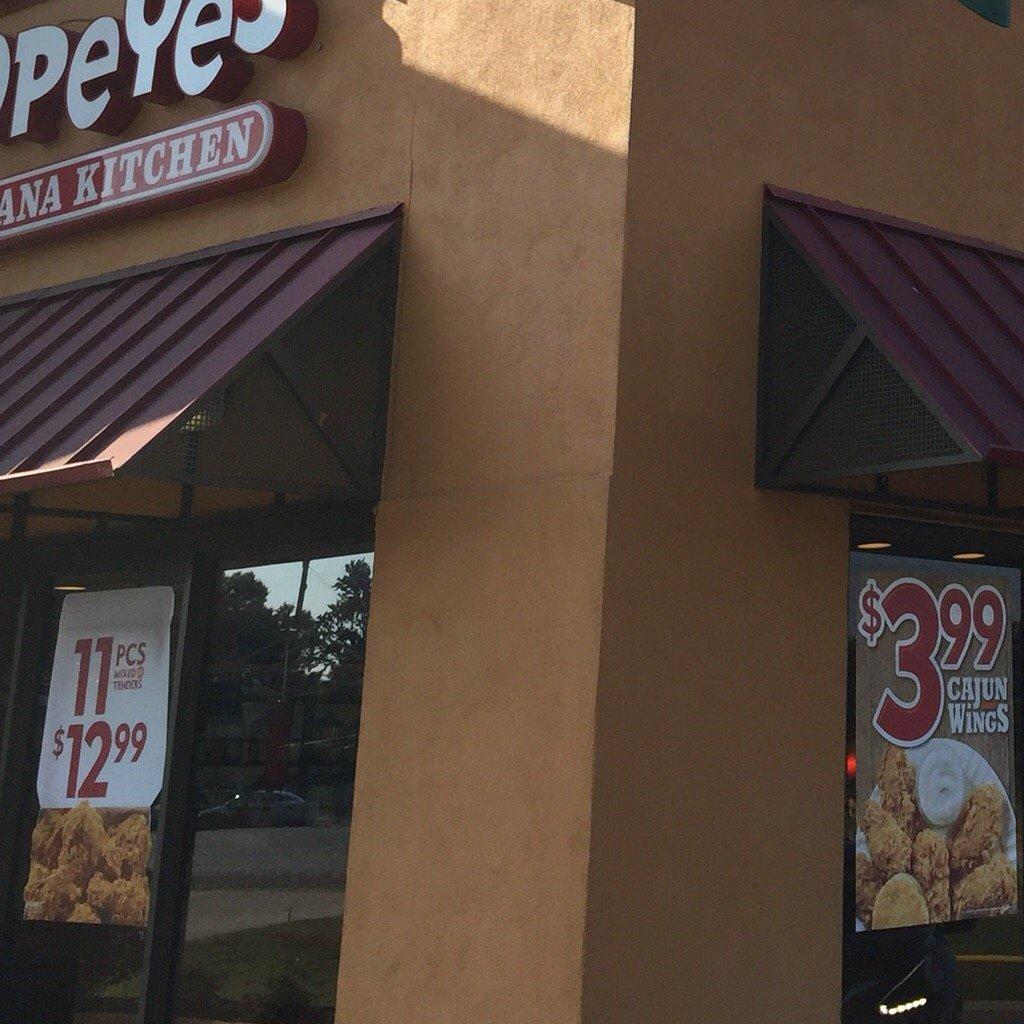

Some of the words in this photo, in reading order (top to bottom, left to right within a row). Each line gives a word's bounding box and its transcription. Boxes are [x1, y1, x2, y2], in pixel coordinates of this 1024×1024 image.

[73, 116, 256, 207] KITCHEN
[74, 636, 114, 717] 11
[116, 641, 147, 667] PCS
[947, 677, 1008, 709] CAJUN
